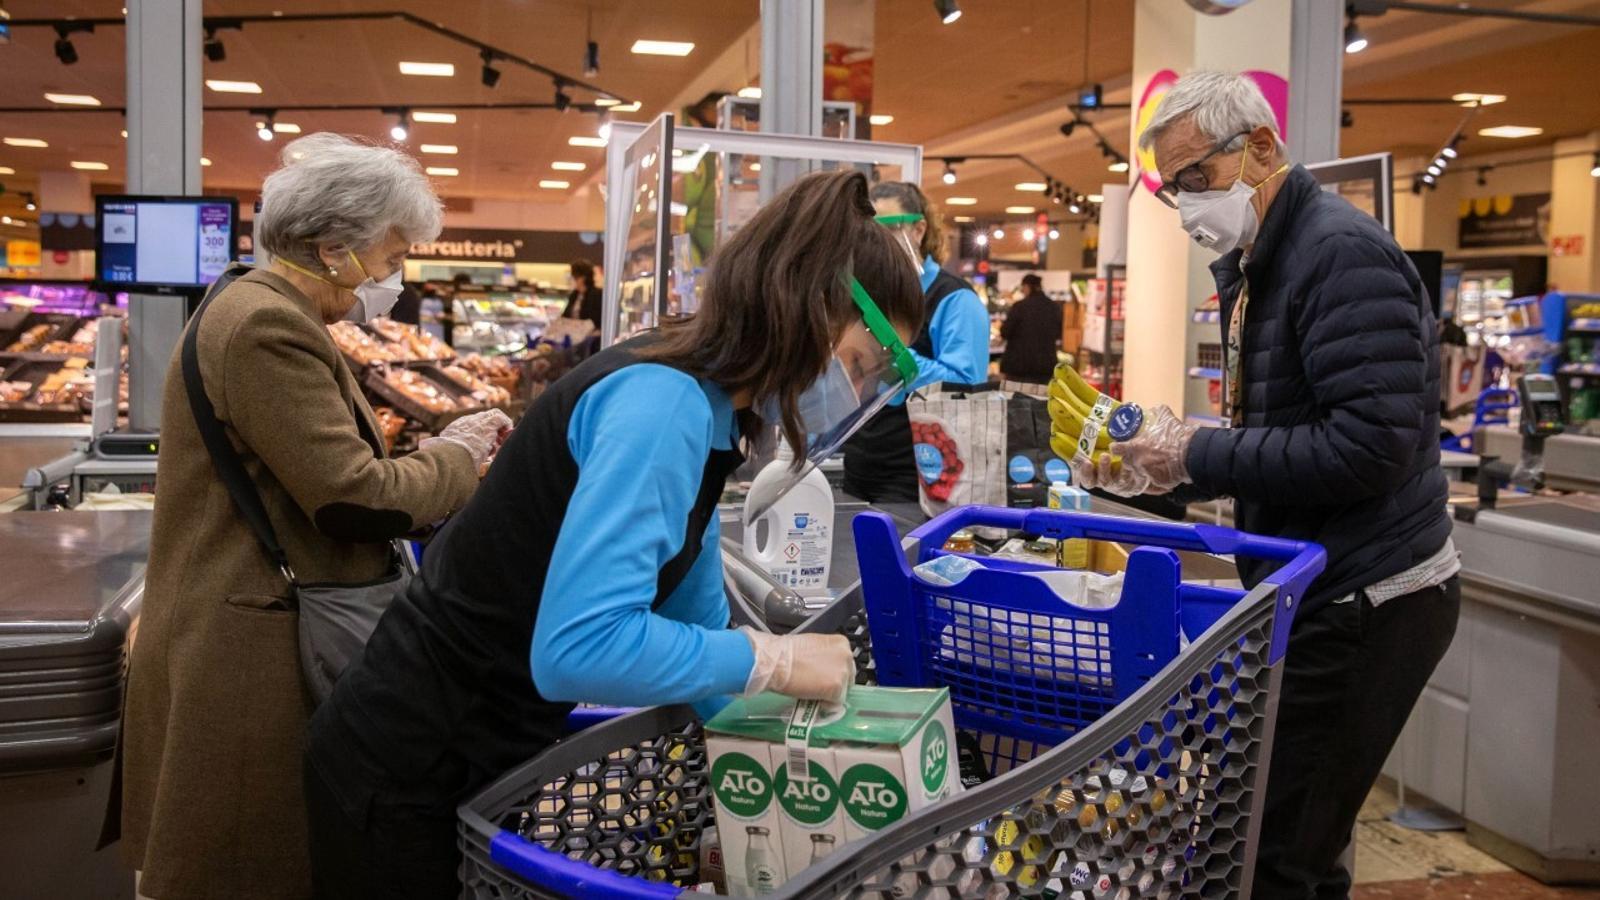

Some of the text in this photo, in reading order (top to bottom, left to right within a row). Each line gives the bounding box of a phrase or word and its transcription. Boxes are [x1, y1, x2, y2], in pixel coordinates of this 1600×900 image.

[925, 735, 945, 777] ATO
[719, 769, 765, 796] ATO
[783, 776, 831, 802] ATO
[847, 781, 898, 808] ATO
[795, 803, 821, 812] Natura
[860, 808, 888, 818] Natura
